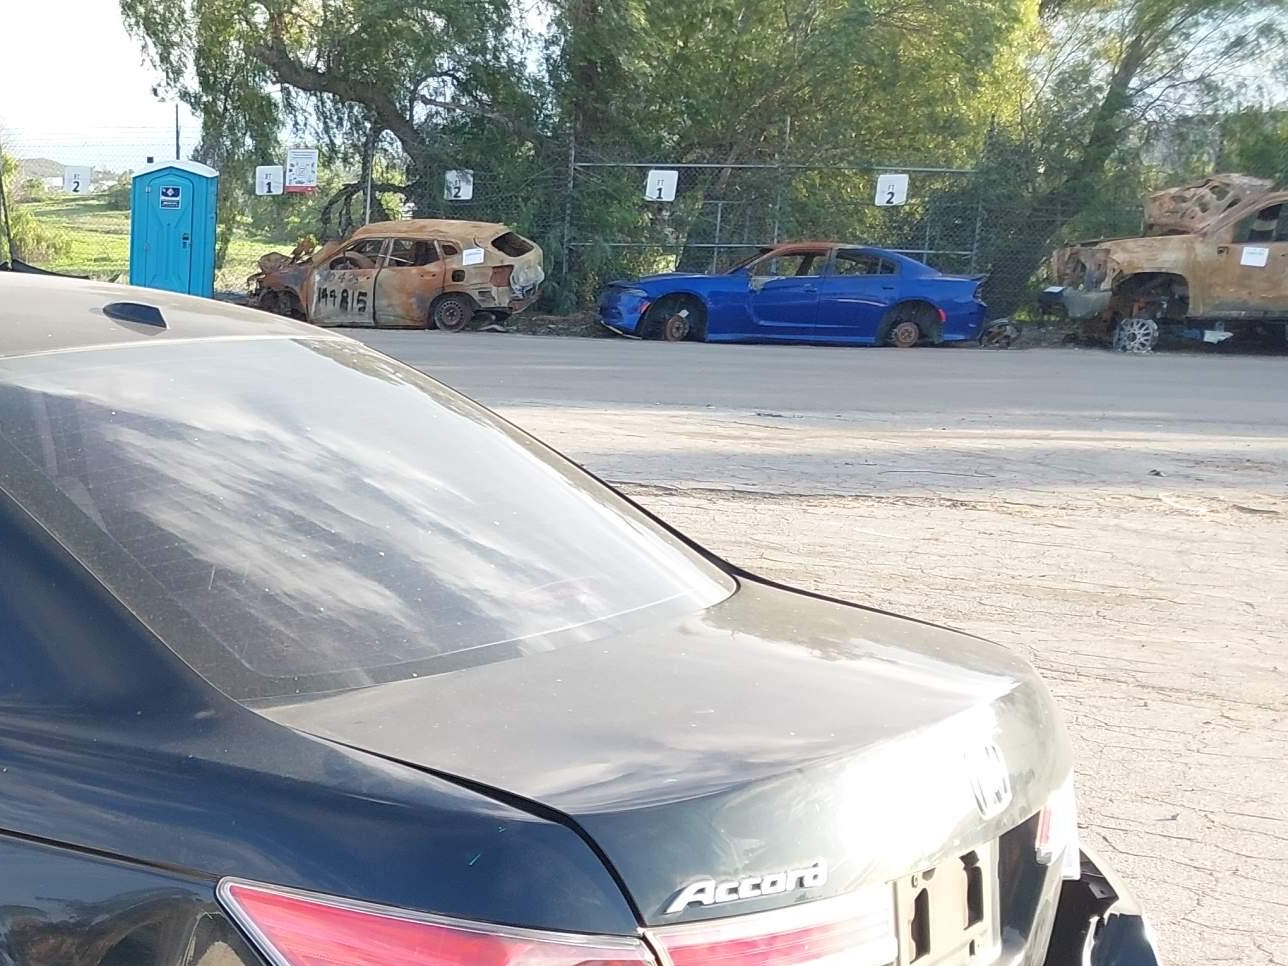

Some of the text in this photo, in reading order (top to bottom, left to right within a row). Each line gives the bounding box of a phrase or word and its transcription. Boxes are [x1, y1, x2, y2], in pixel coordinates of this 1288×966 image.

[72, 181, 80, 193] 2
[265, 181, 273, 194] 1
[452, 186, 462, 198] 2
[655, 187, 664, 200] 1
[885, 191, 895, 205] 2
[664, 856, 828, 914] Accord
